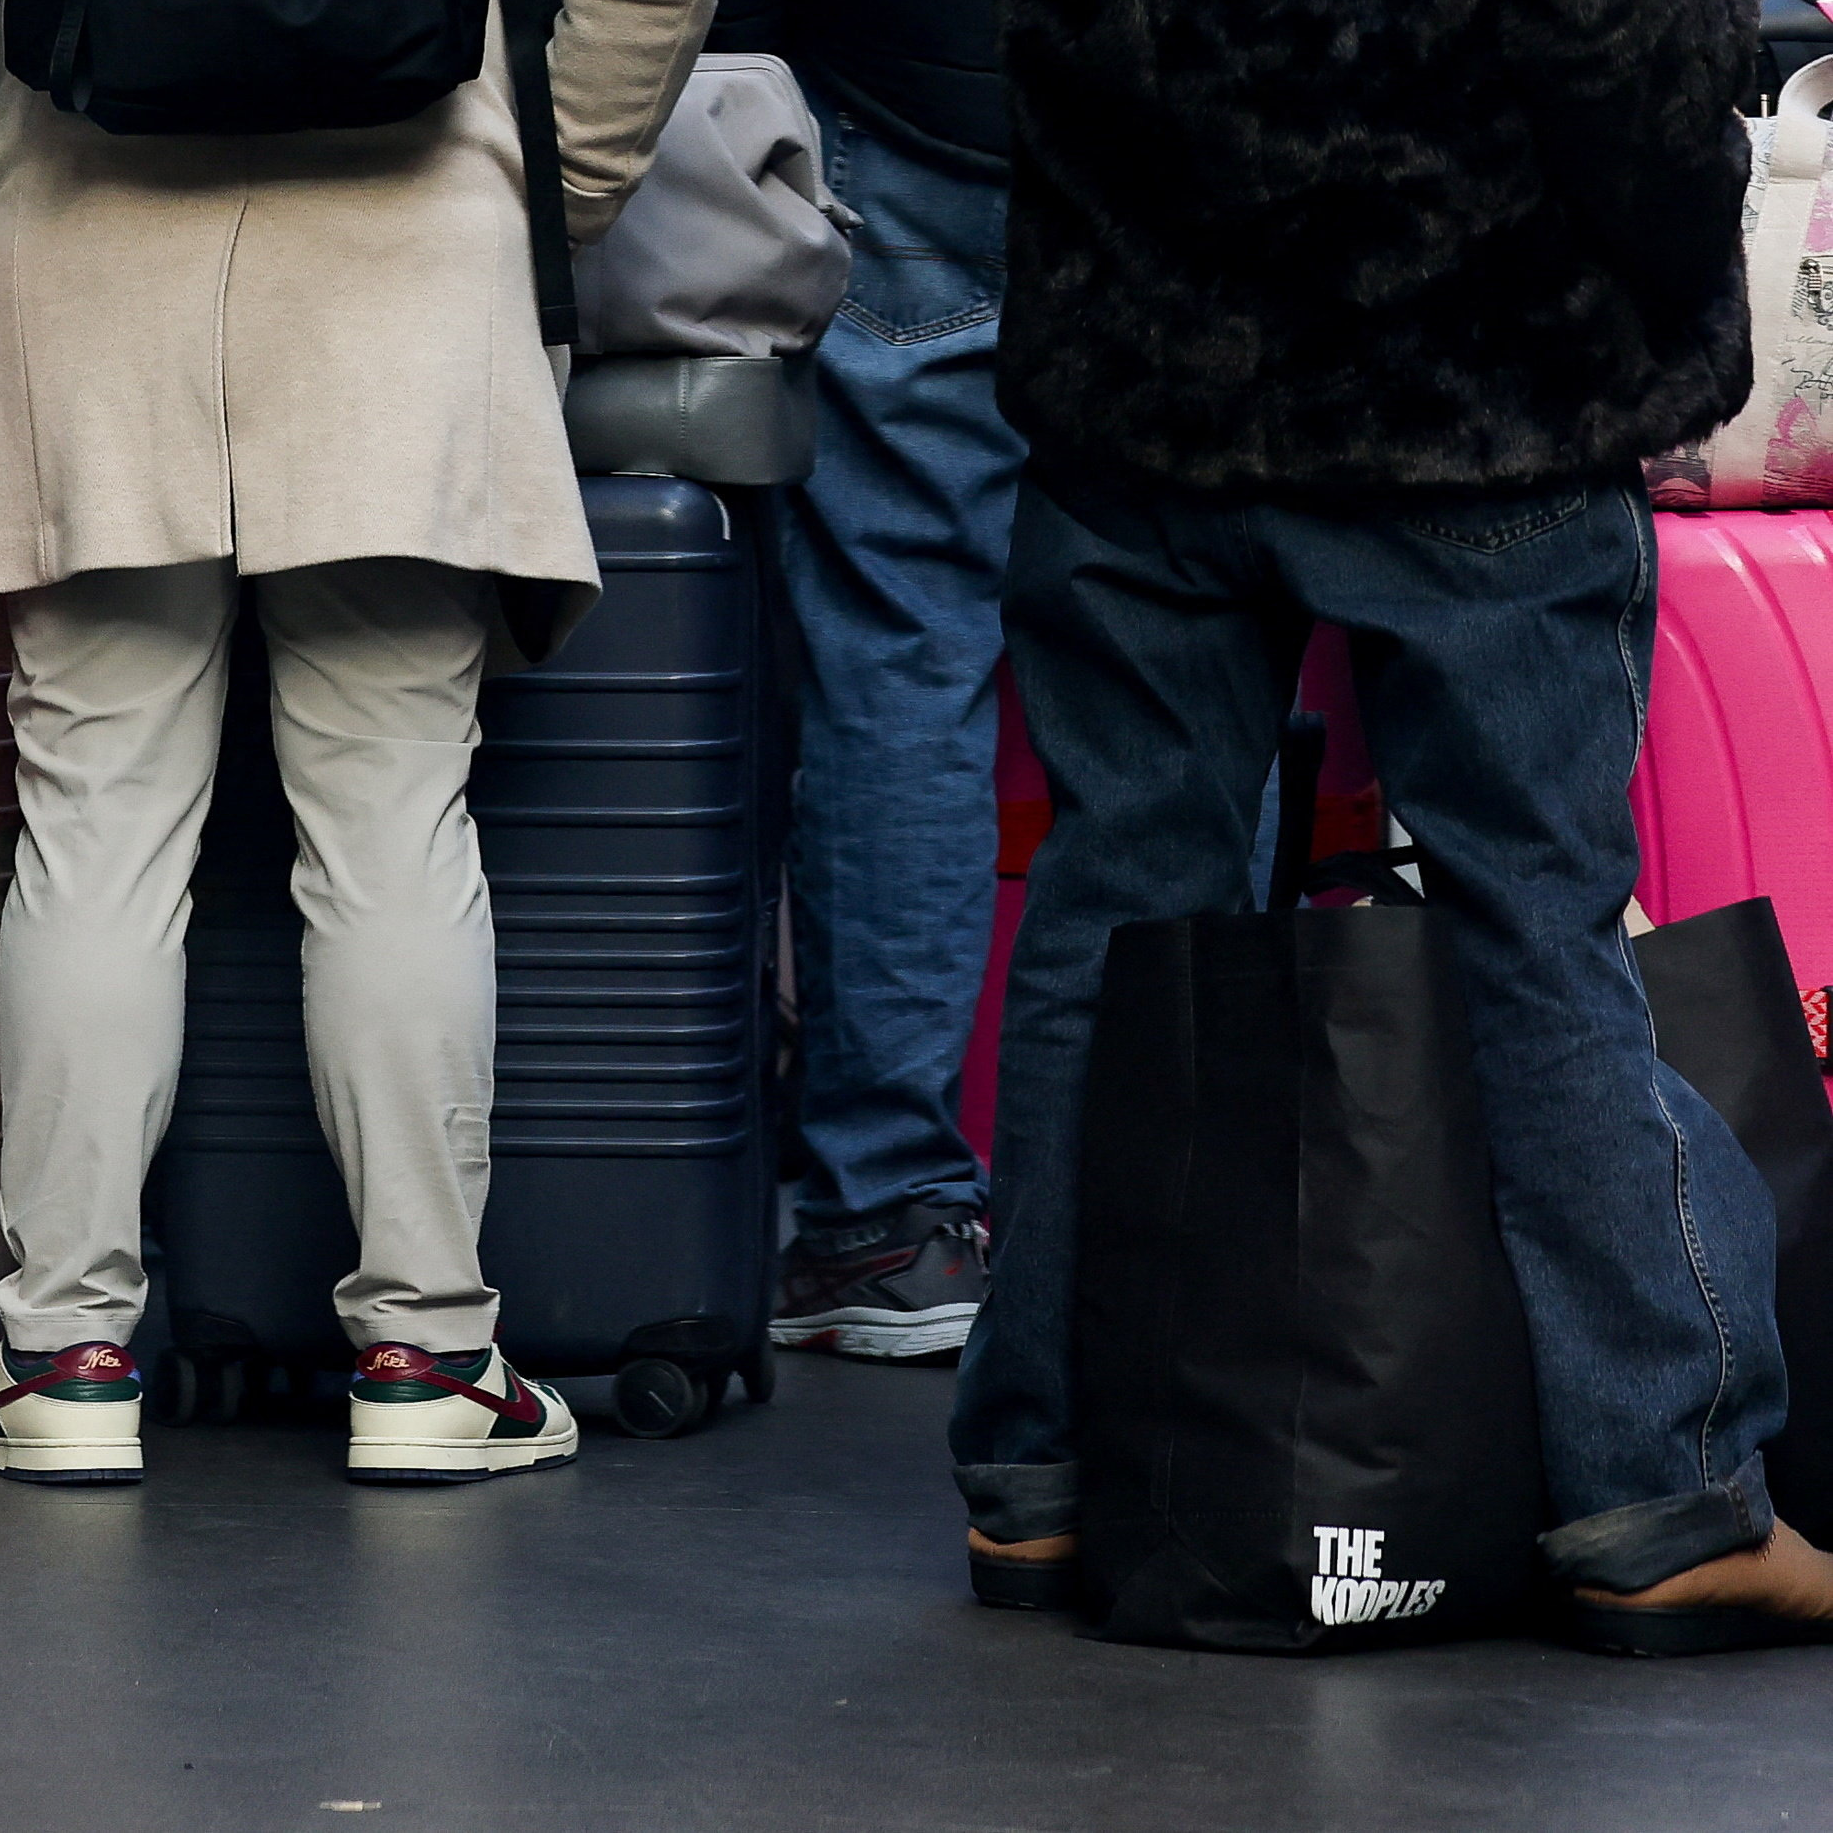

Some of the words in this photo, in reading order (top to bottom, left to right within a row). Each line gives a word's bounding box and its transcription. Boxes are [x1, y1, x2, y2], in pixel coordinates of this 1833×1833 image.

[77, 1348, 122, 1370] Nike
[366, 1349, 410, 1371] Nike
[1313, 1525, 1385, 1579] THE
[1311, 1575, 1446, 1626] KOOPLES
